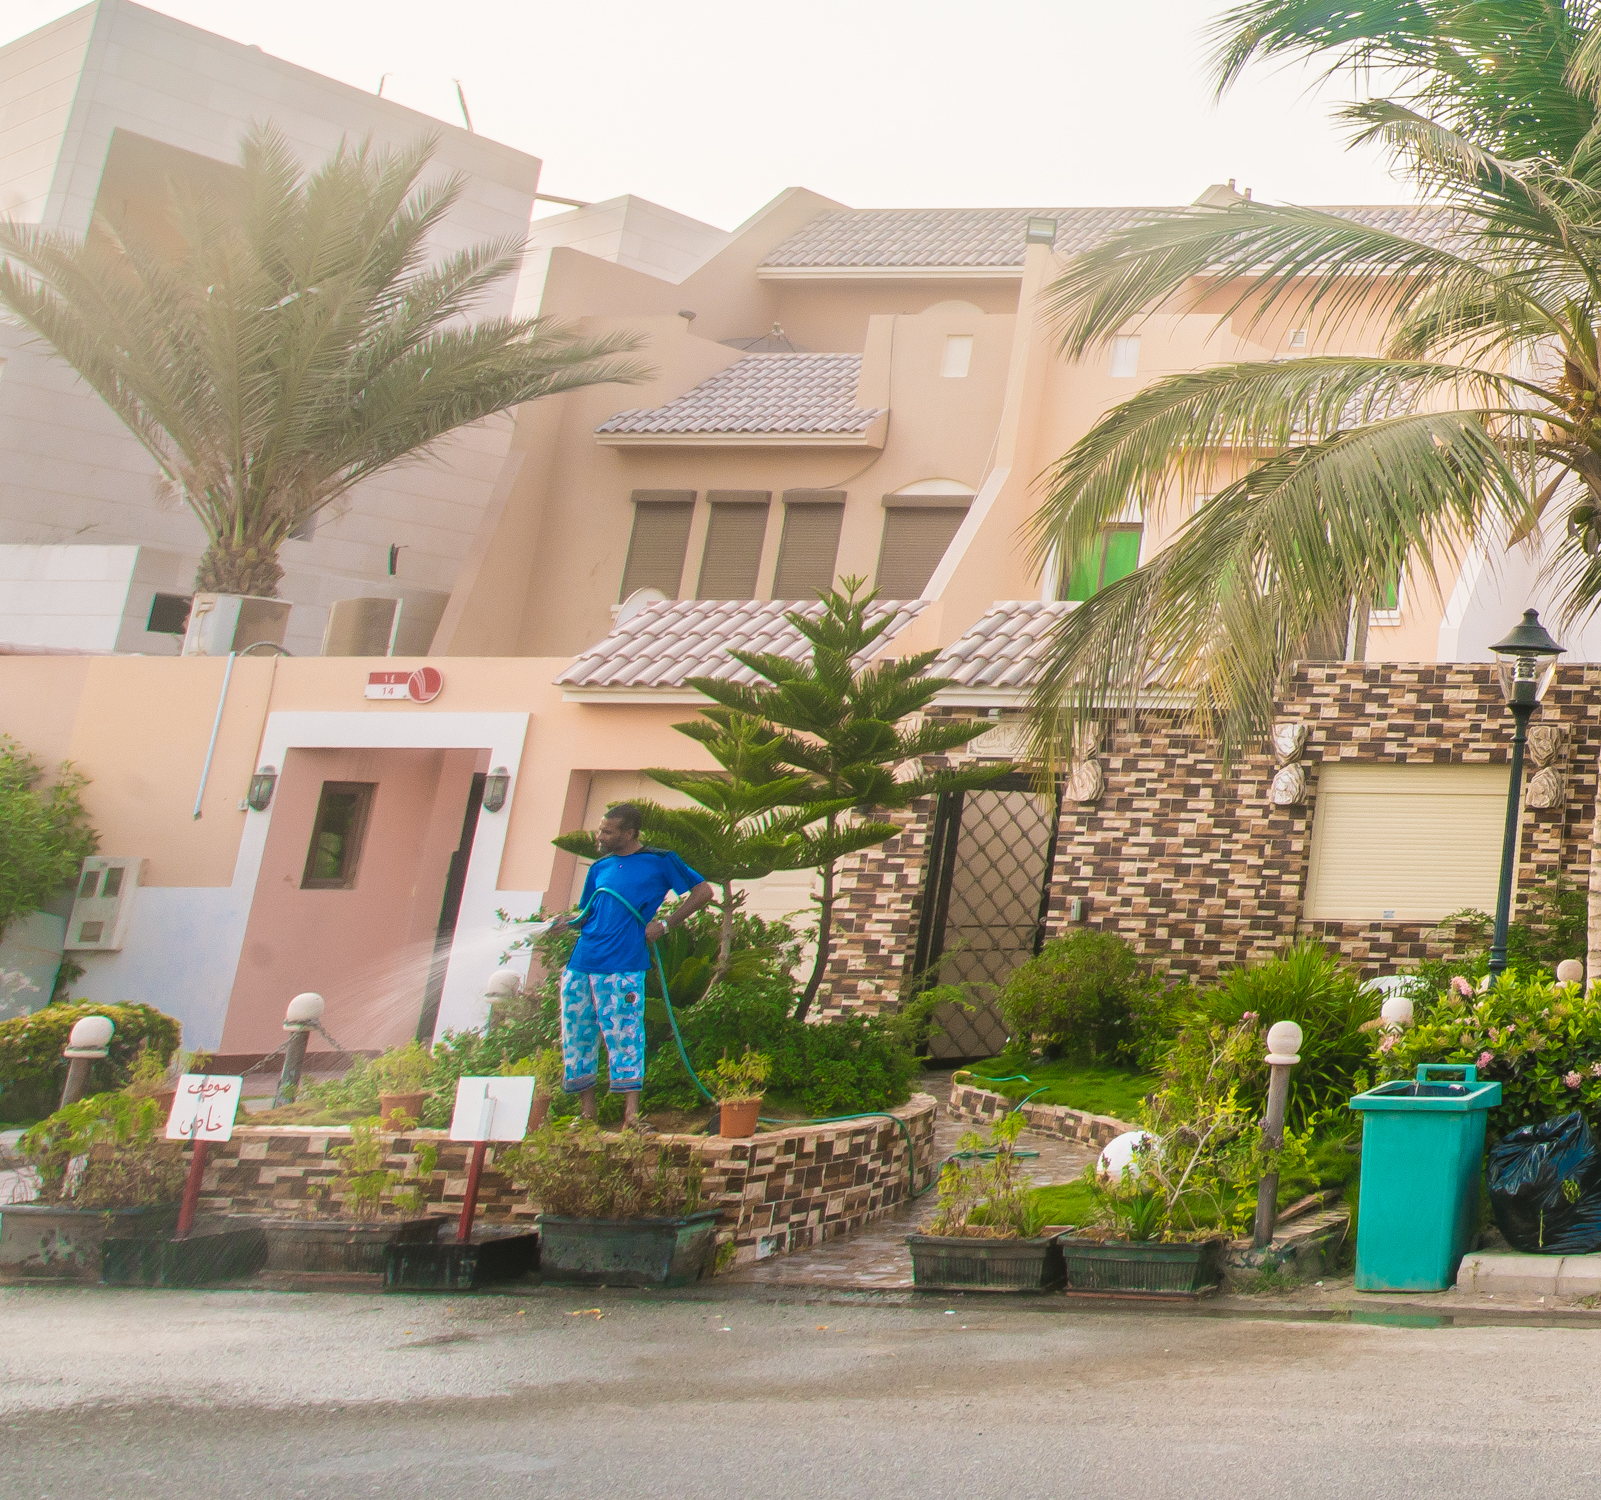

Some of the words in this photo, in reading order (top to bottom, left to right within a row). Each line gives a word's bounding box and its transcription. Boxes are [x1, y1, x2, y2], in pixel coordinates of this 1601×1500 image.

[384, 674, 396, 684] ١٤
[382, 686, 394, 696] 14
[179, 1104, 223, 1136] خاص
